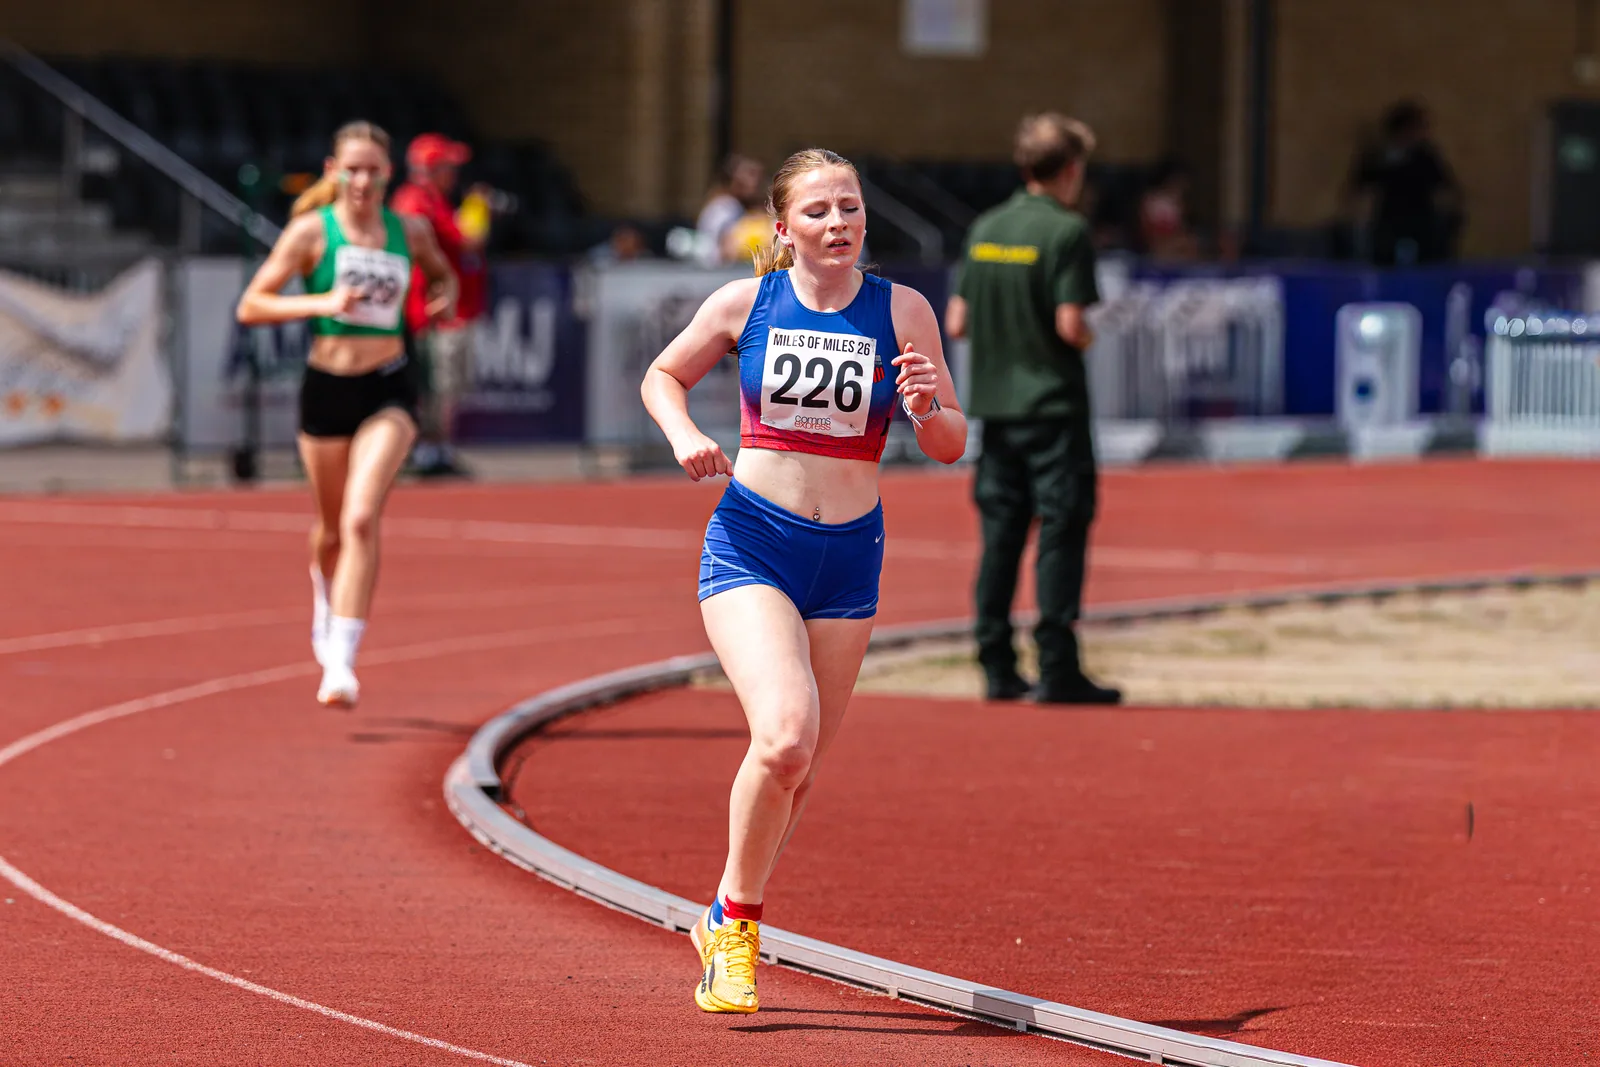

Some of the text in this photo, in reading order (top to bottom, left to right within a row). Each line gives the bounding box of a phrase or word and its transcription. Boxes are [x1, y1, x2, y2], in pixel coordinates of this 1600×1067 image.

[773, 333, 871, 356] MILES OF MILES 26
[770, 353, 864, 412] 226
[794, 415, 831, 425] comms
[794, 421, 831, 430] express
